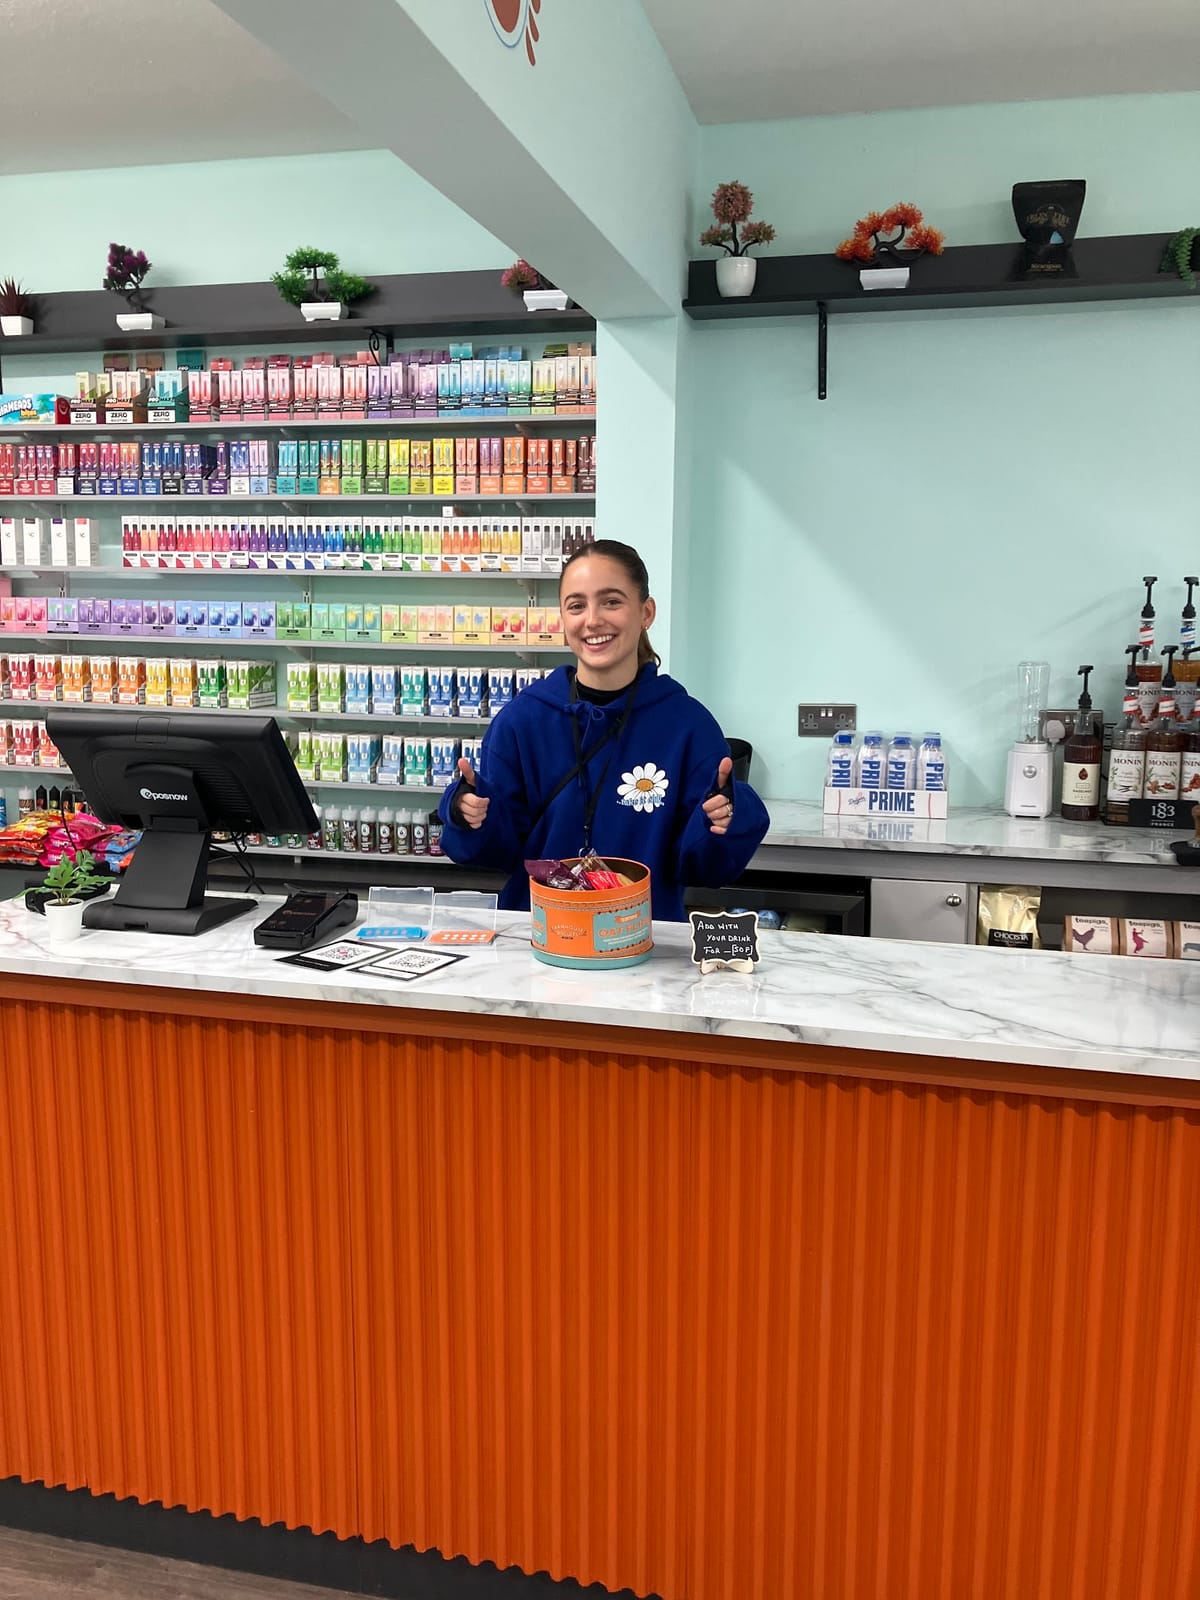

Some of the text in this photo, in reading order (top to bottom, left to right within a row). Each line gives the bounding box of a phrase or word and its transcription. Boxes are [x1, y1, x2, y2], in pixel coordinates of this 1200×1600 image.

[0, 398, 33, 417] IRHEADS
[1113, 757, 1142, 766] MONIN
[1149, 759, 1178, 767] MONIN
[868, 790, 915, 811] PRIME
[706, 934, 726, 942] YOUR
[703, 946, 721, 954] FOR
